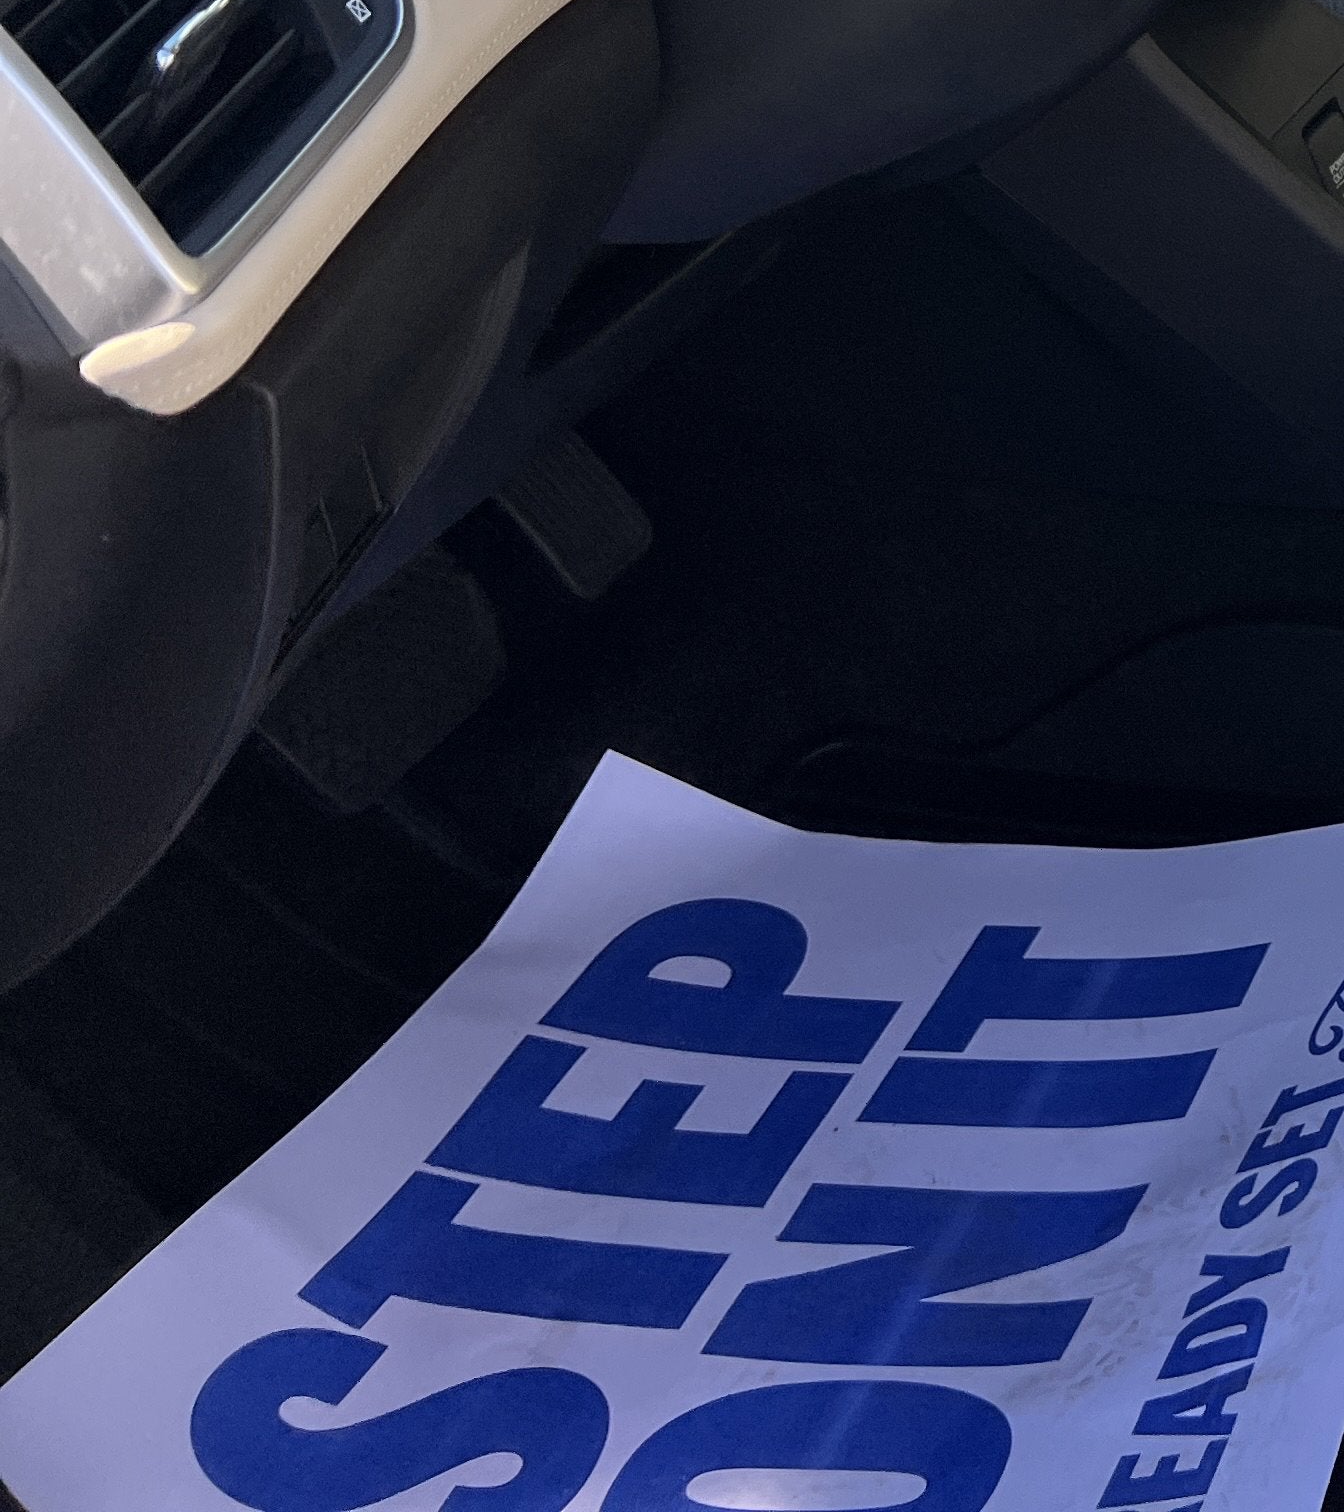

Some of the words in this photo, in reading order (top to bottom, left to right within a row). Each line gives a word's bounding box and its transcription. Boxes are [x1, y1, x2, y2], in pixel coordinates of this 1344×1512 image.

[856, 924, 1272, 1129] IT
[190, 897, 903, 1512] STEP
[1096, 1245, 1291, 1512] EADY
